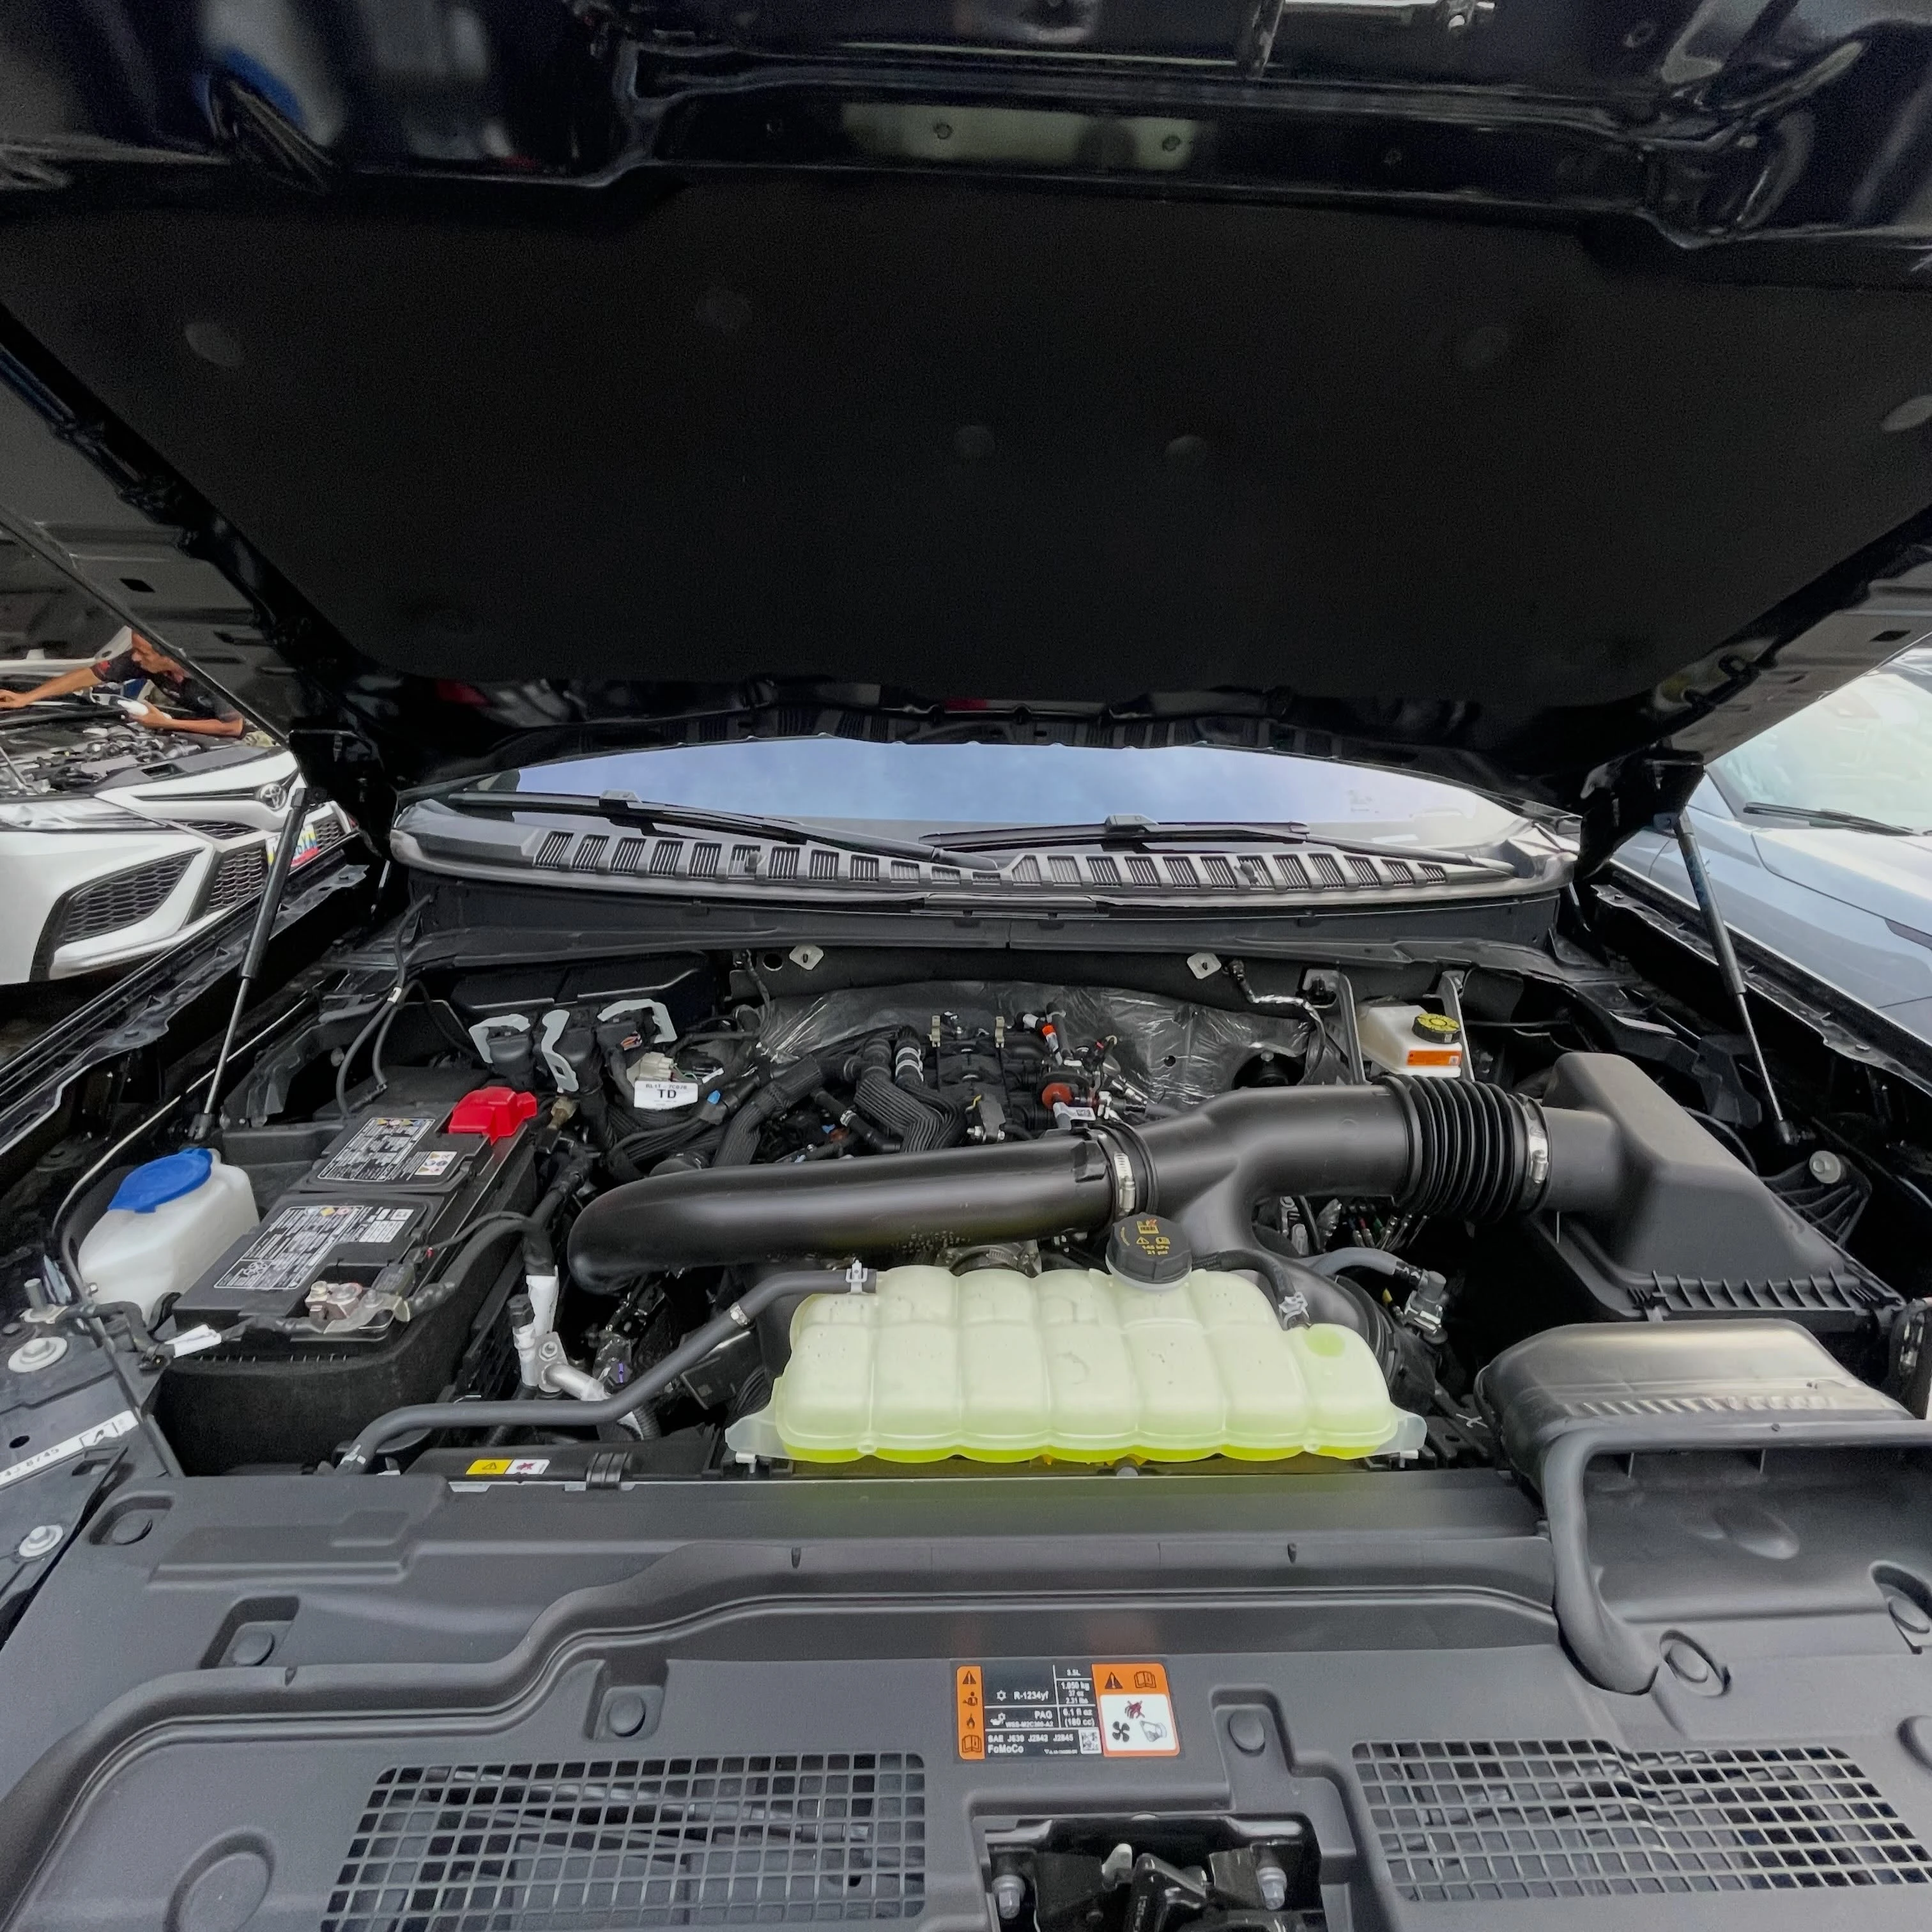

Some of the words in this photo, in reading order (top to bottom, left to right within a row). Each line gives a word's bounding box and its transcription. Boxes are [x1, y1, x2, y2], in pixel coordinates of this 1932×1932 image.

[657, 1089, 677, 1099] TD
[1013, 1690, 1049, 1701] R-1234yf
[1034, 1710, 1053, 1719] PAG
[988, 1744, 1023, 1754] FoMoCo
